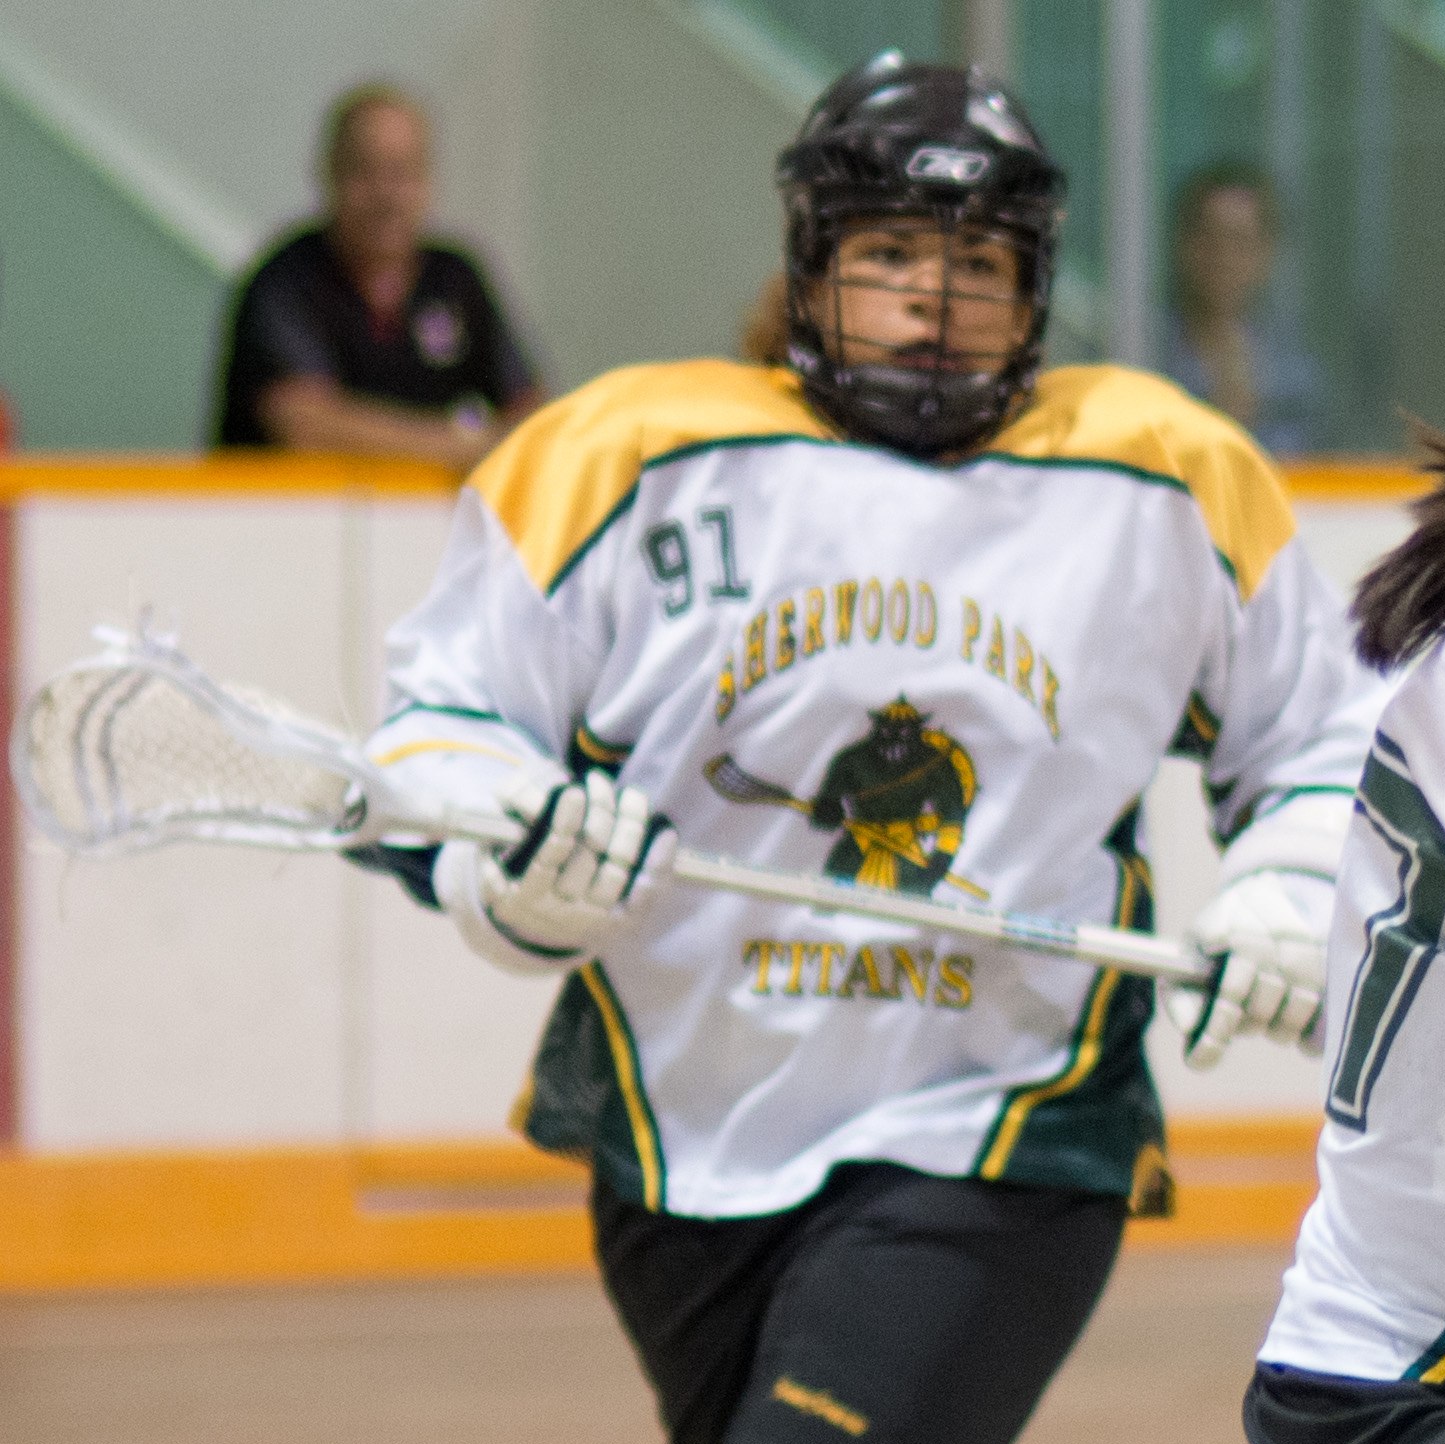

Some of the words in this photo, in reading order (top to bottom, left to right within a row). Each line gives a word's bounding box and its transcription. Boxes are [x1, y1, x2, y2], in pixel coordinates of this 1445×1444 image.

[641, 504, 752, 621] 91
[961, 594, 1060, 742] PARK
[741, 938, 976, 1012] TITANS
